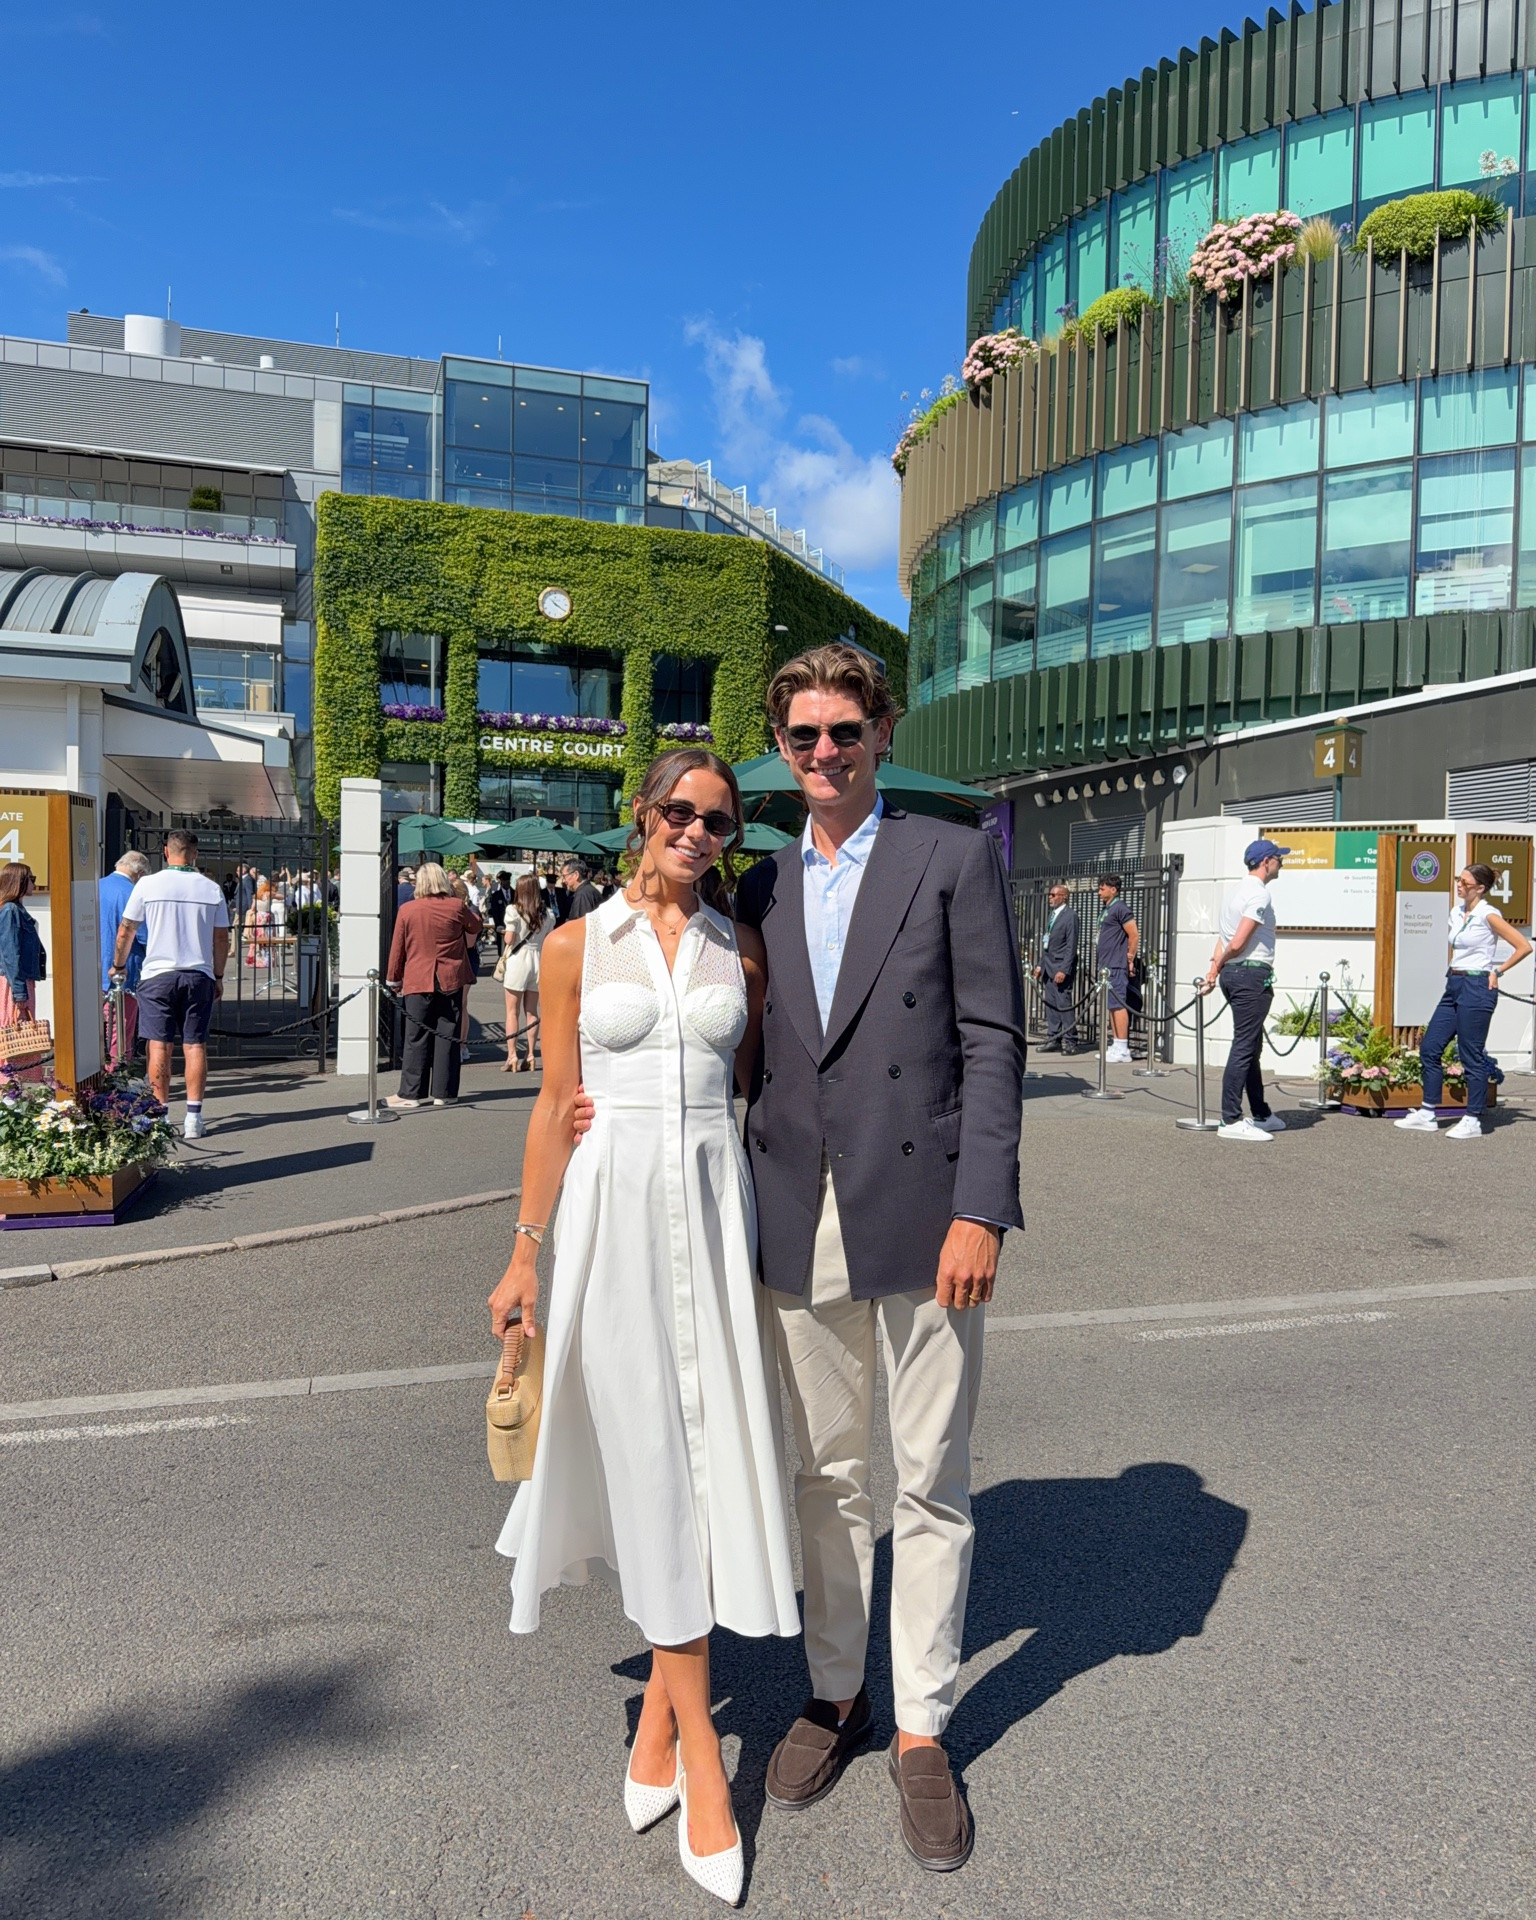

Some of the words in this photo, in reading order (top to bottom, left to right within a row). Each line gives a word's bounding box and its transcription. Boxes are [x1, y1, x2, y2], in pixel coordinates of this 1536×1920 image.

[479, 736, 554, 753] CENTRE
[562, 742, 625, 757] COURT
[1323, 747, 1336, 768] 4
[1349, 748, 1356, 768] 4
[0, 812, 24, 821] ATE
[0, 829, 25, 863] 4
[1282, 857, 1305, 865] pitality
[1491, 854, 1513, 864] GATE
[1490, 869, 1513, 904] 4
